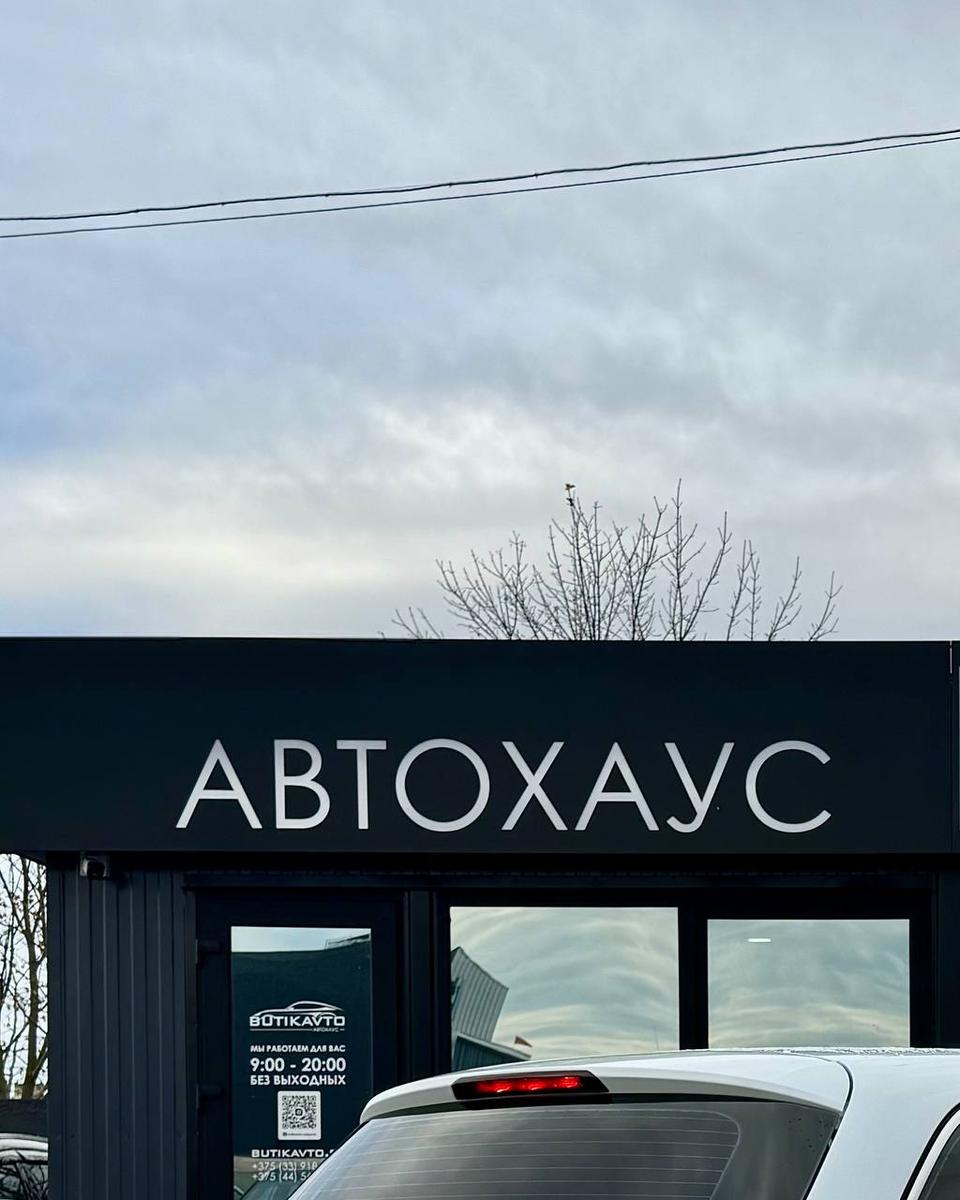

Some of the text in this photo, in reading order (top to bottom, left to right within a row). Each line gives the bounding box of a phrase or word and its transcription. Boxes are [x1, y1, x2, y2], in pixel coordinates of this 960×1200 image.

[176, 738, 831, 833] АВТОХАУС
[249, 1015, 346, 1027] BUTIKAVTO
[250, 1045, 346, 1053] МЫ РАБОТАЕМ ДЛЯ ВАС
[250, 1058, 285, 1072] 9:00
[301, 1058, 346, 1072] 20:00
[250, 1075, 346, 1087] БЕЗ ВЫХОДНЫХ
[251, 1149, 334, 1158] BUTIKAVTO.
[252, 1161, 276, 1171] +375
[278, 1161, 297, 1173] (33)
[252, 1171, 276, 1181] +375
[278, 1171, 297, 1183] (44)
